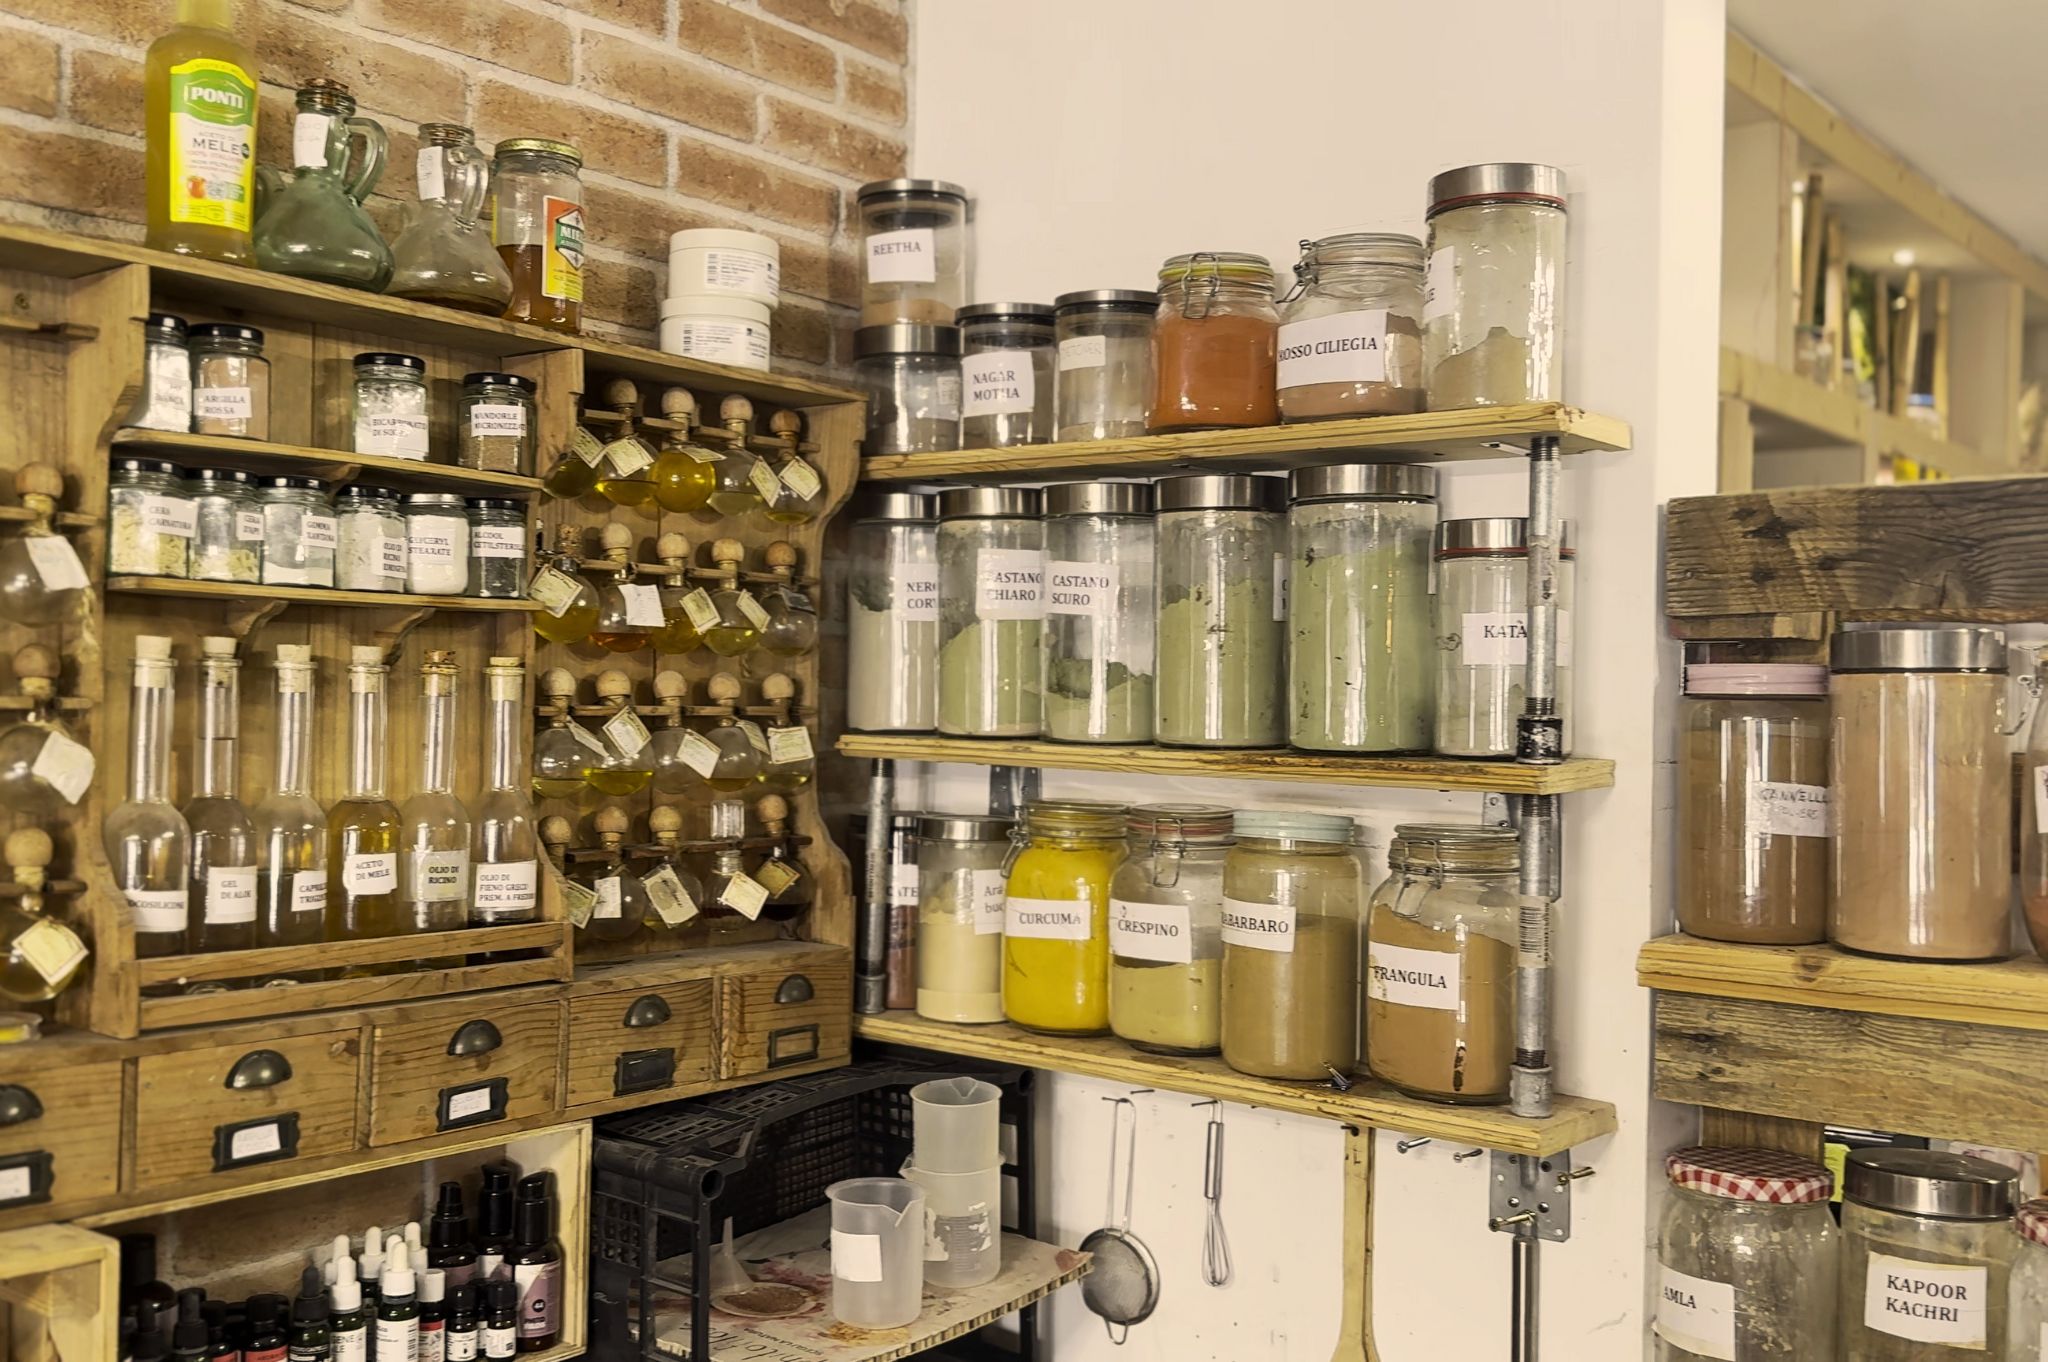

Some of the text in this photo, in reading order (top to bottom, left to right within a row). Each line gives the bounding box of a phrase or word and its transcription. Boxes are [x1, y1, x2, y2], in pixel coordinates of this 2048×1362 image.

[191, 86, 243, 109] PONTI
[192, 138, 239, 156] MELE
[873, 241, 921, 256] REETHA
[1279, 337, 1378, 361] ROSSO CILIEGIA
[973, 370, 1016, 384] NAGAR
[474, 412, 518, 420] MANDORLE
[474, 531, 504, 540] ALCOOL
[987, 572, 1041, 584] ASTANO
[1053, 575, 1109, 588] CASTANO
[1052, 593, 1090, 606] SCURO
[356, 860, 384, 869] ACETO
[429, 866, 449, 874] OLIO
[356, 872, 366, 881] DI
[480, 874, 500, 882] OLIO
[221, 880, 238, 888] GEL
[479, 884, 503, 892] FIENO
[1019, 912, 1081, 925] CURCUMA
[1118, 918, 1179, 937] CRESPINO
[1374, 966, 1447, 989] FRANGULA
[1887, 1275, 1968, 1301] KAPOOR
[1663, 1285, 1697, 1309] AMLA
[1886, 1296, 1959, 1322] KACHRI
